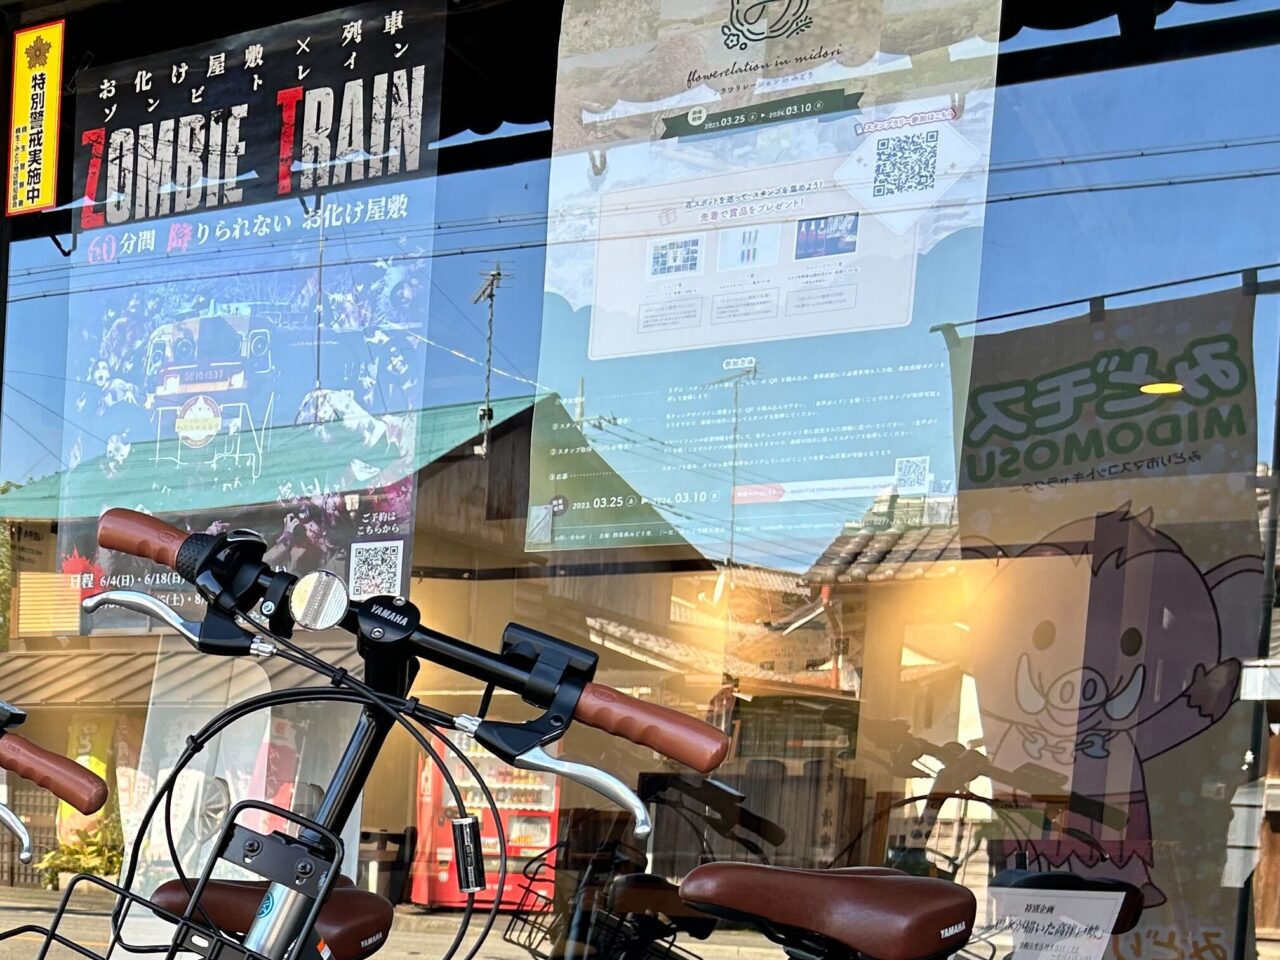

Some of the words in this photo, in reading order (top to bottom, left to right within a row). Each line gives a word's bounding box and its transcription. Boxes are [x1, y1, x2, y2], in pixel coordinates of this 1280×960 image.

[686, 60, 771, 88] flowerelation
[775, 55, 791, 67] in
[795, 44, 843, 63] midori
[26, 73, 46, 204] 特別警戒実施中
[80, 103, 249, 229] ZOMBIE
[276, 65, 426, 195] TRAIN
[87, 228, 155, 264] 60分間
[166, 216, 292, 253] 降りられない
[302, 193, 409, 229] お化け屋敷
[361, 511, 396, 523] ご予約は
[357, 523, 400, 536] こちらから
[70, 573, 95, 589] 日程
[370, 603, 409, 627] YAMAHA
[361, 931, 383, 948] YAMAHA
[940, 920, 966, 939] YAMAHA
